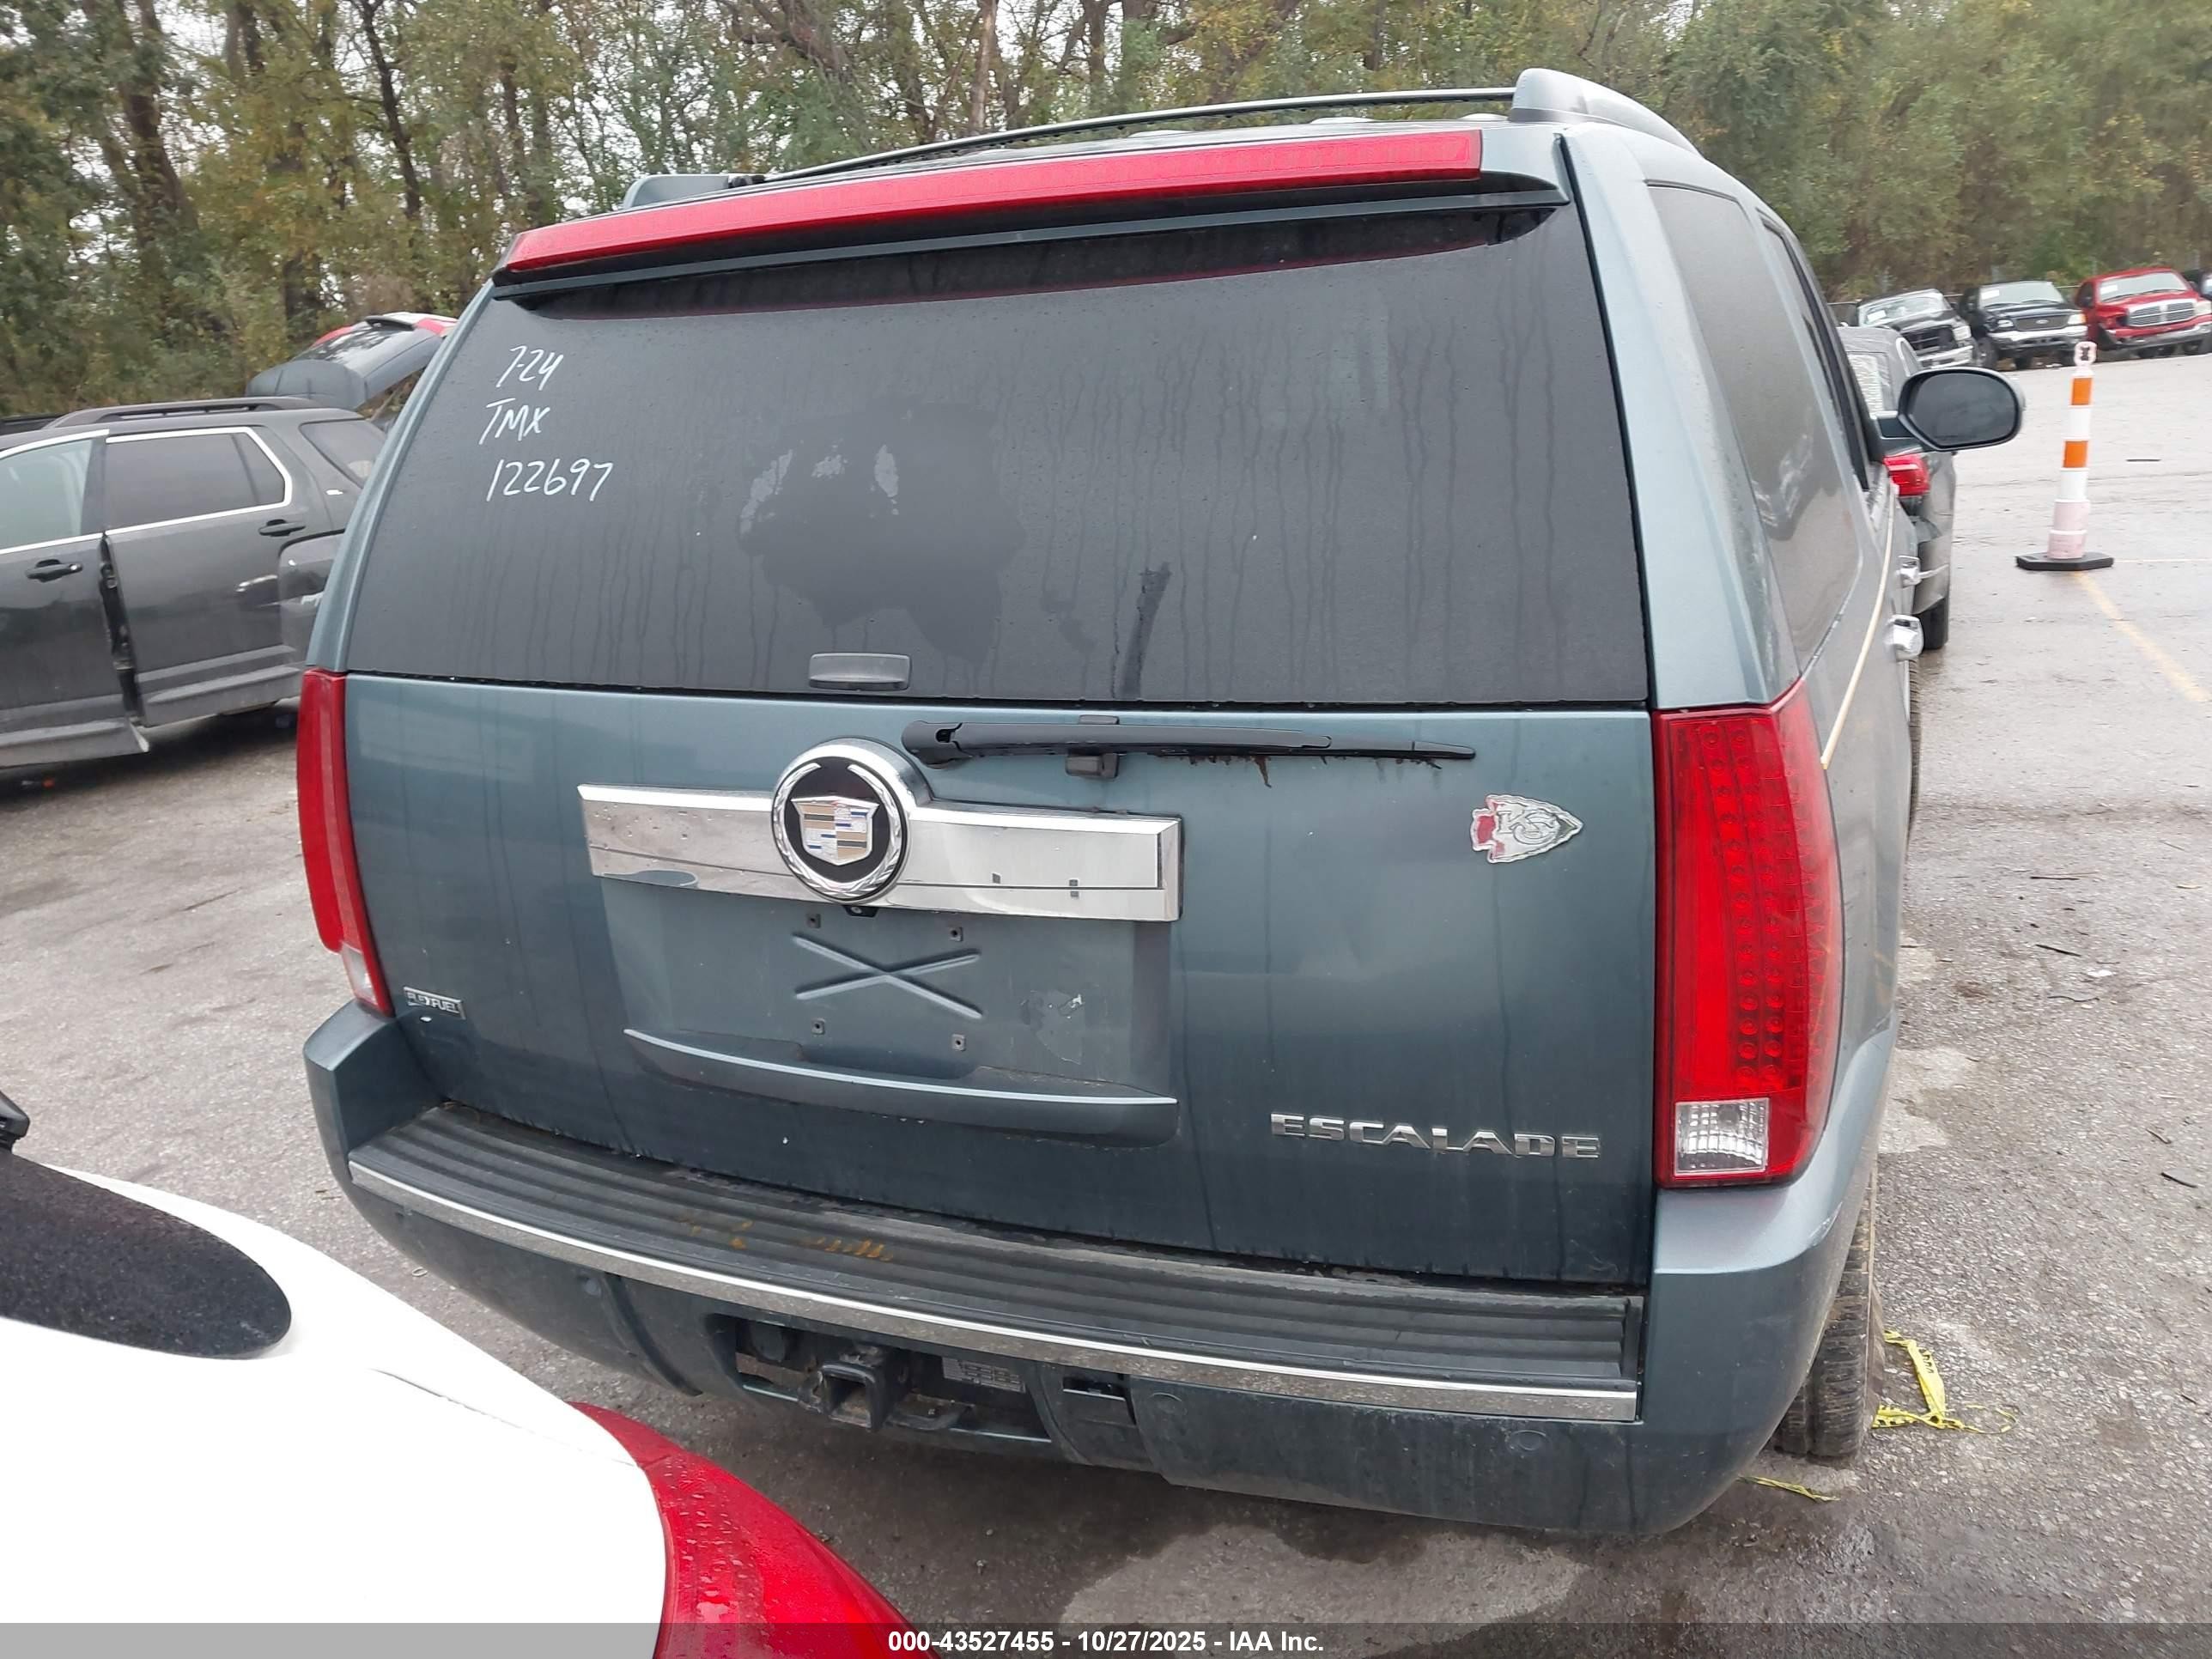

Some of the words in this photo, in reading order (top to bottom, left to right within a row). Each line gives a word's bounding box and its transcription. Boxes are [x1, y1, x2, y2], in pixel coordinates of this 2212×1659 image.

[495, 345, 564, 391] 7-24
[478, 398, 550, 445] TMX
[486, 458, 614, 502] 122697
[1270, 1113, 1601, 1159] ESCALADE
